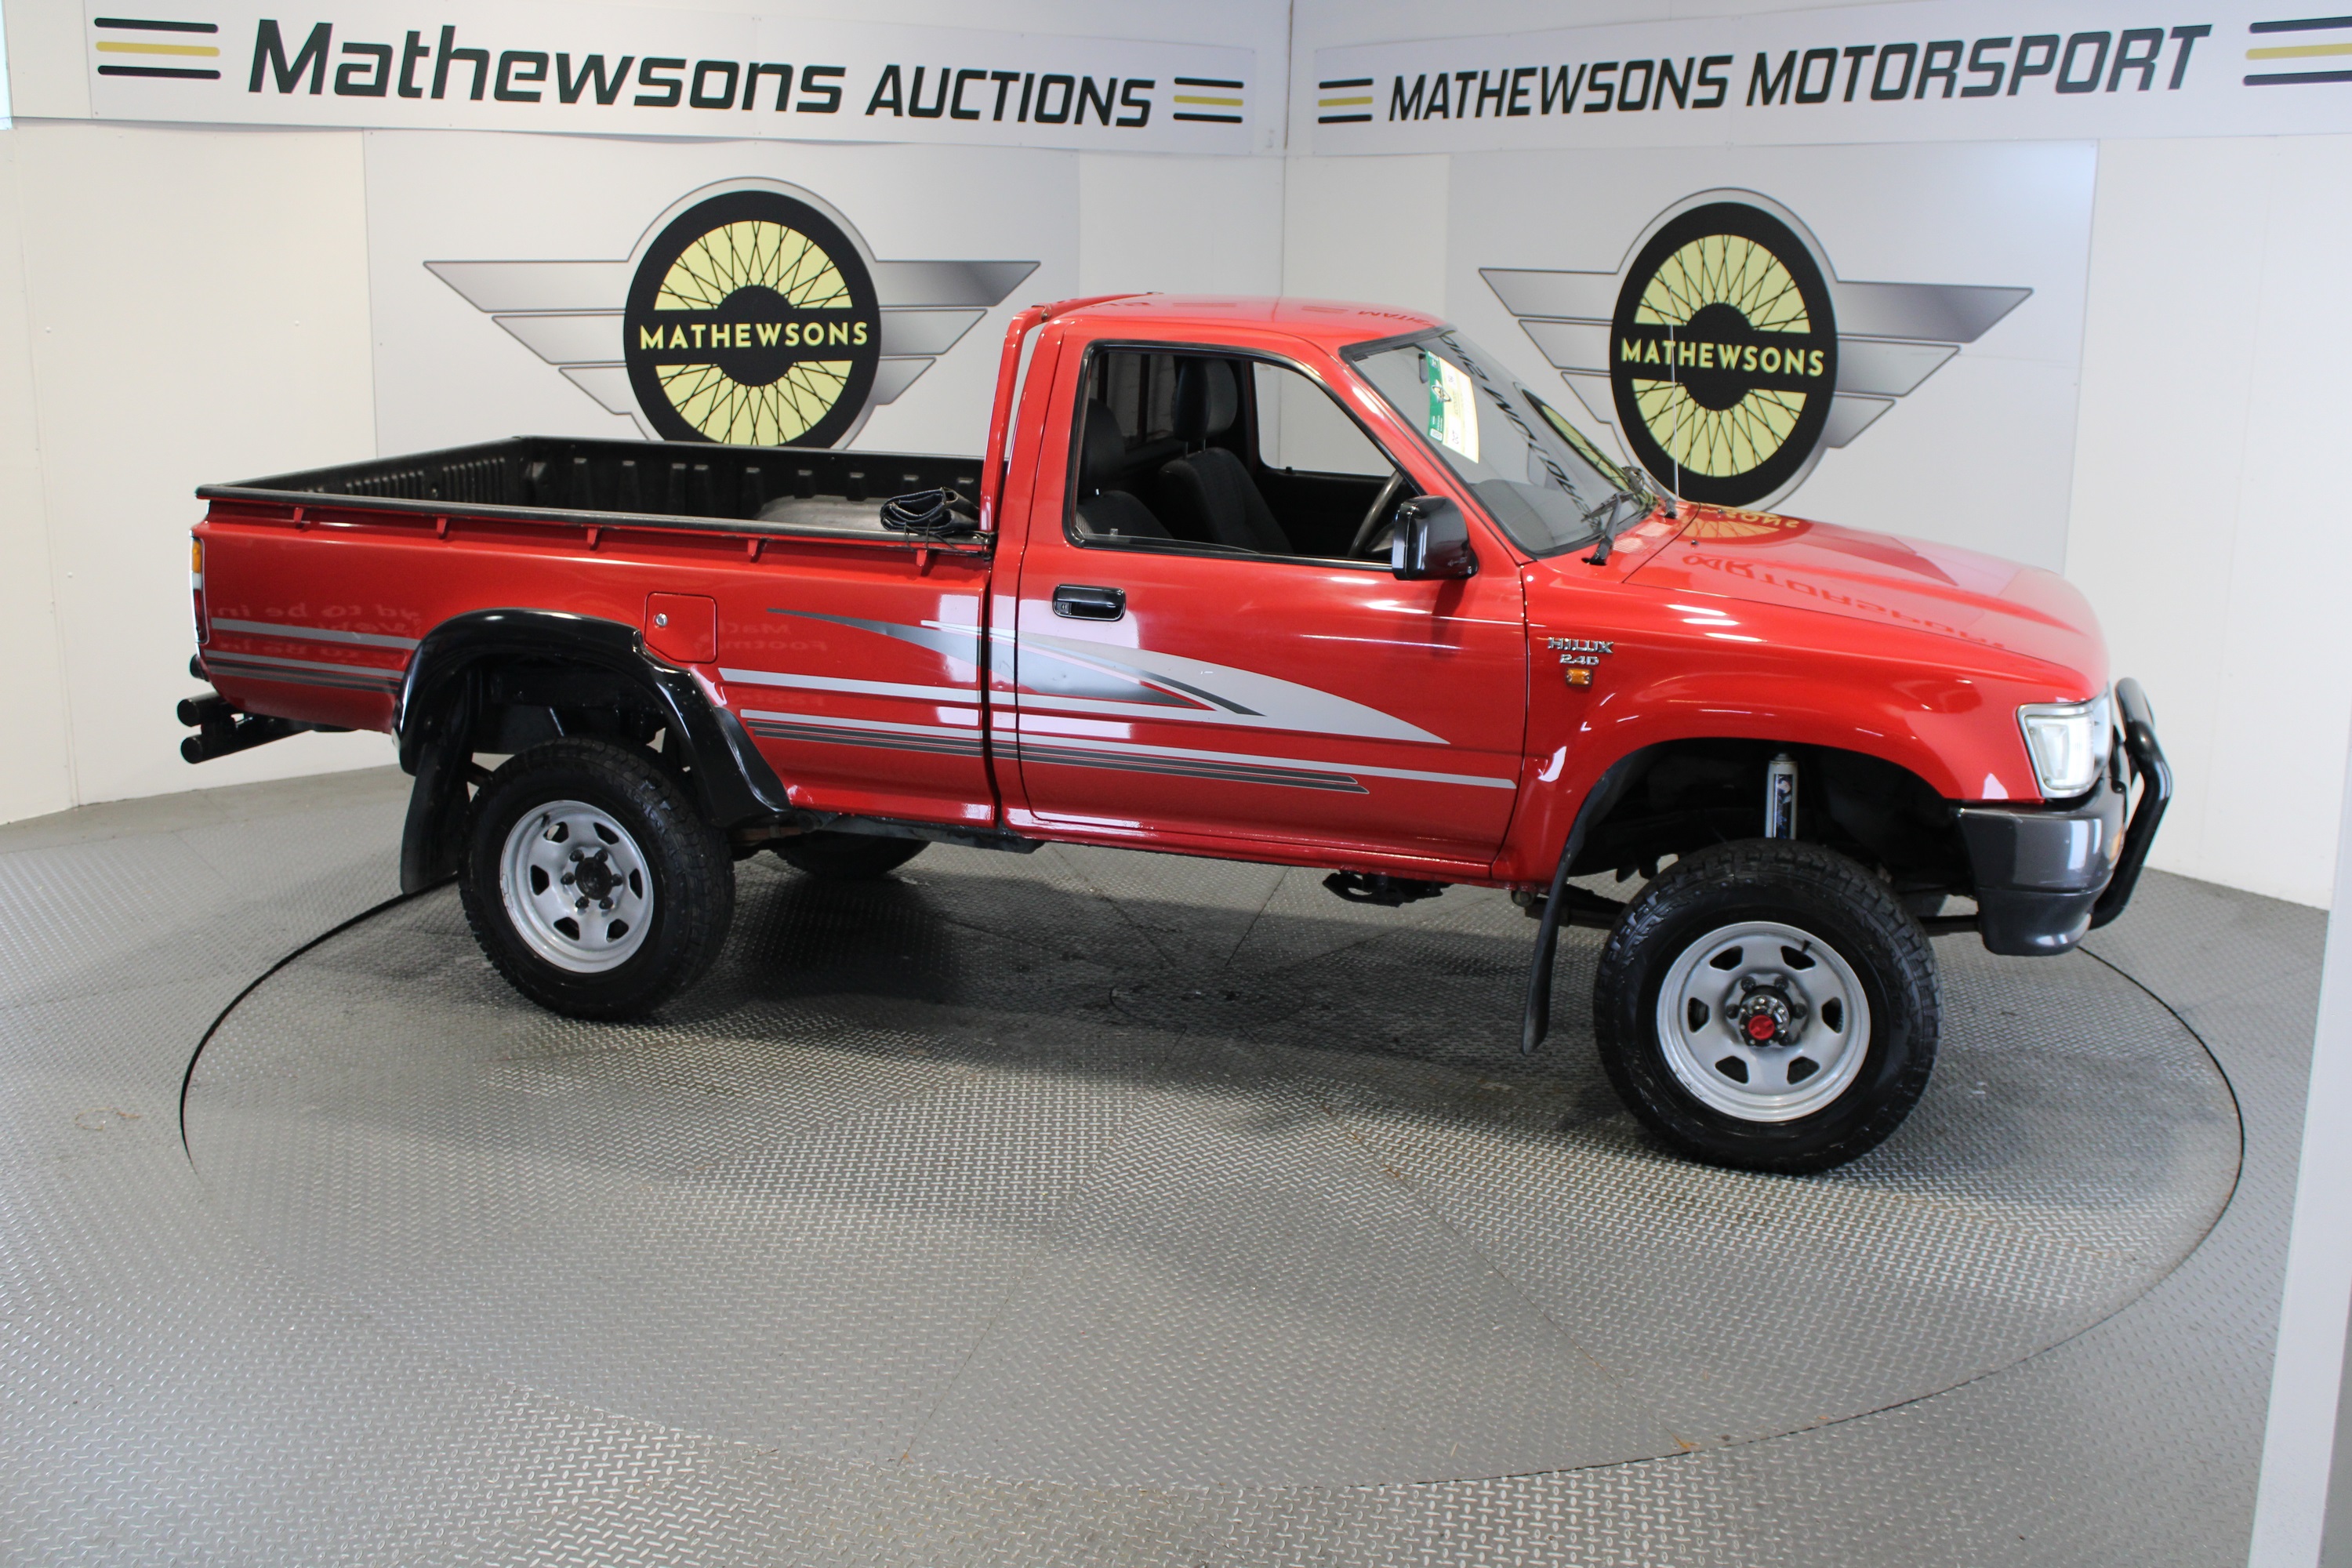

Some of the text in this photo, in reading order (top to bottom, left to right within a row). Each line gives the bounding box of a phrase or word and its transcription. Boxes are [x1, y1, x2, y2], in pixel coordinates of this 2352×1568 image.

[249, 19, 1156, 128] Mathewsons AUCTIONS
[1388, 24, 2212, 122] MATHEWSONS MOTORSPORT
[640, 321, 868, 350] MATHEWSONS
[1621, 337, 1824, 378] MATHEWSONS
[1548, 637, 1614, 654] HILUX
